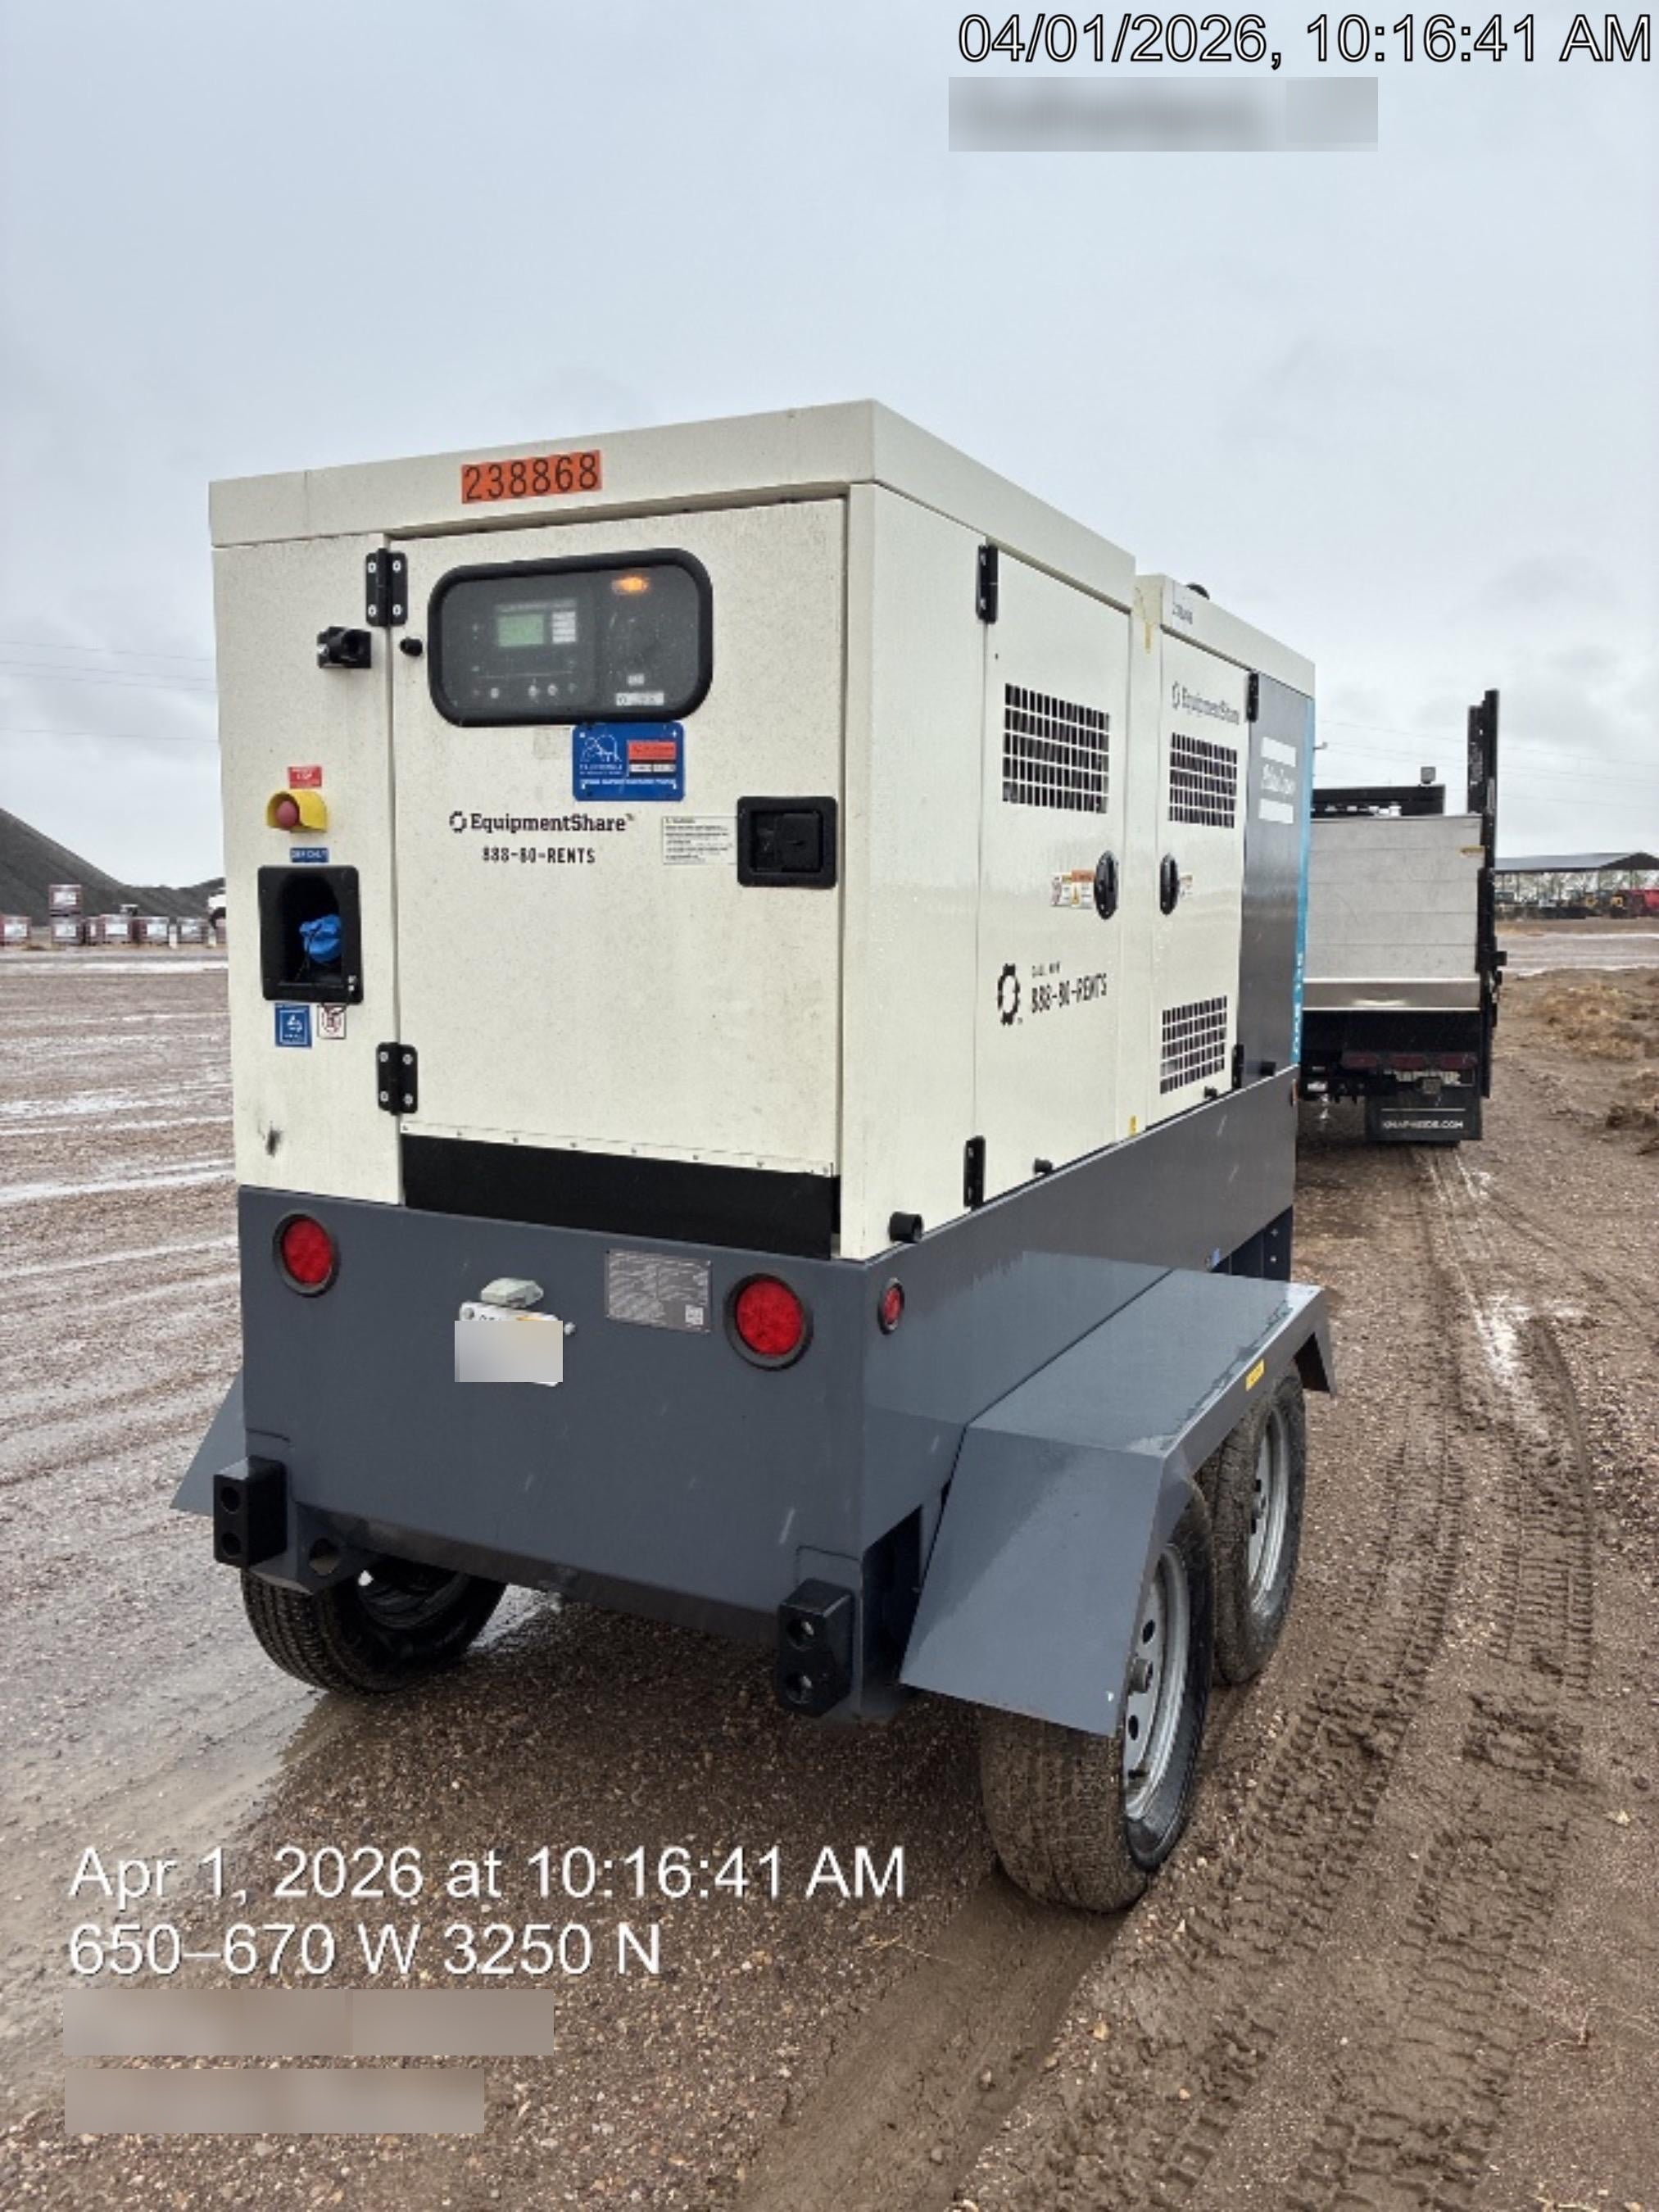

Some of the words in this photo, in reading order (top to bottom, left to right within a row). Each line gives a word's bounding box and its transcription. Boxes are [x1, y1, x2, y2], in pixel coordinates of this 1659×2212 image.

[465, 454, 599, 501] 238868
[470, 814, 626, 833] EquipmentShare
[483, 848, 596, 863] 888-80-RENTS
